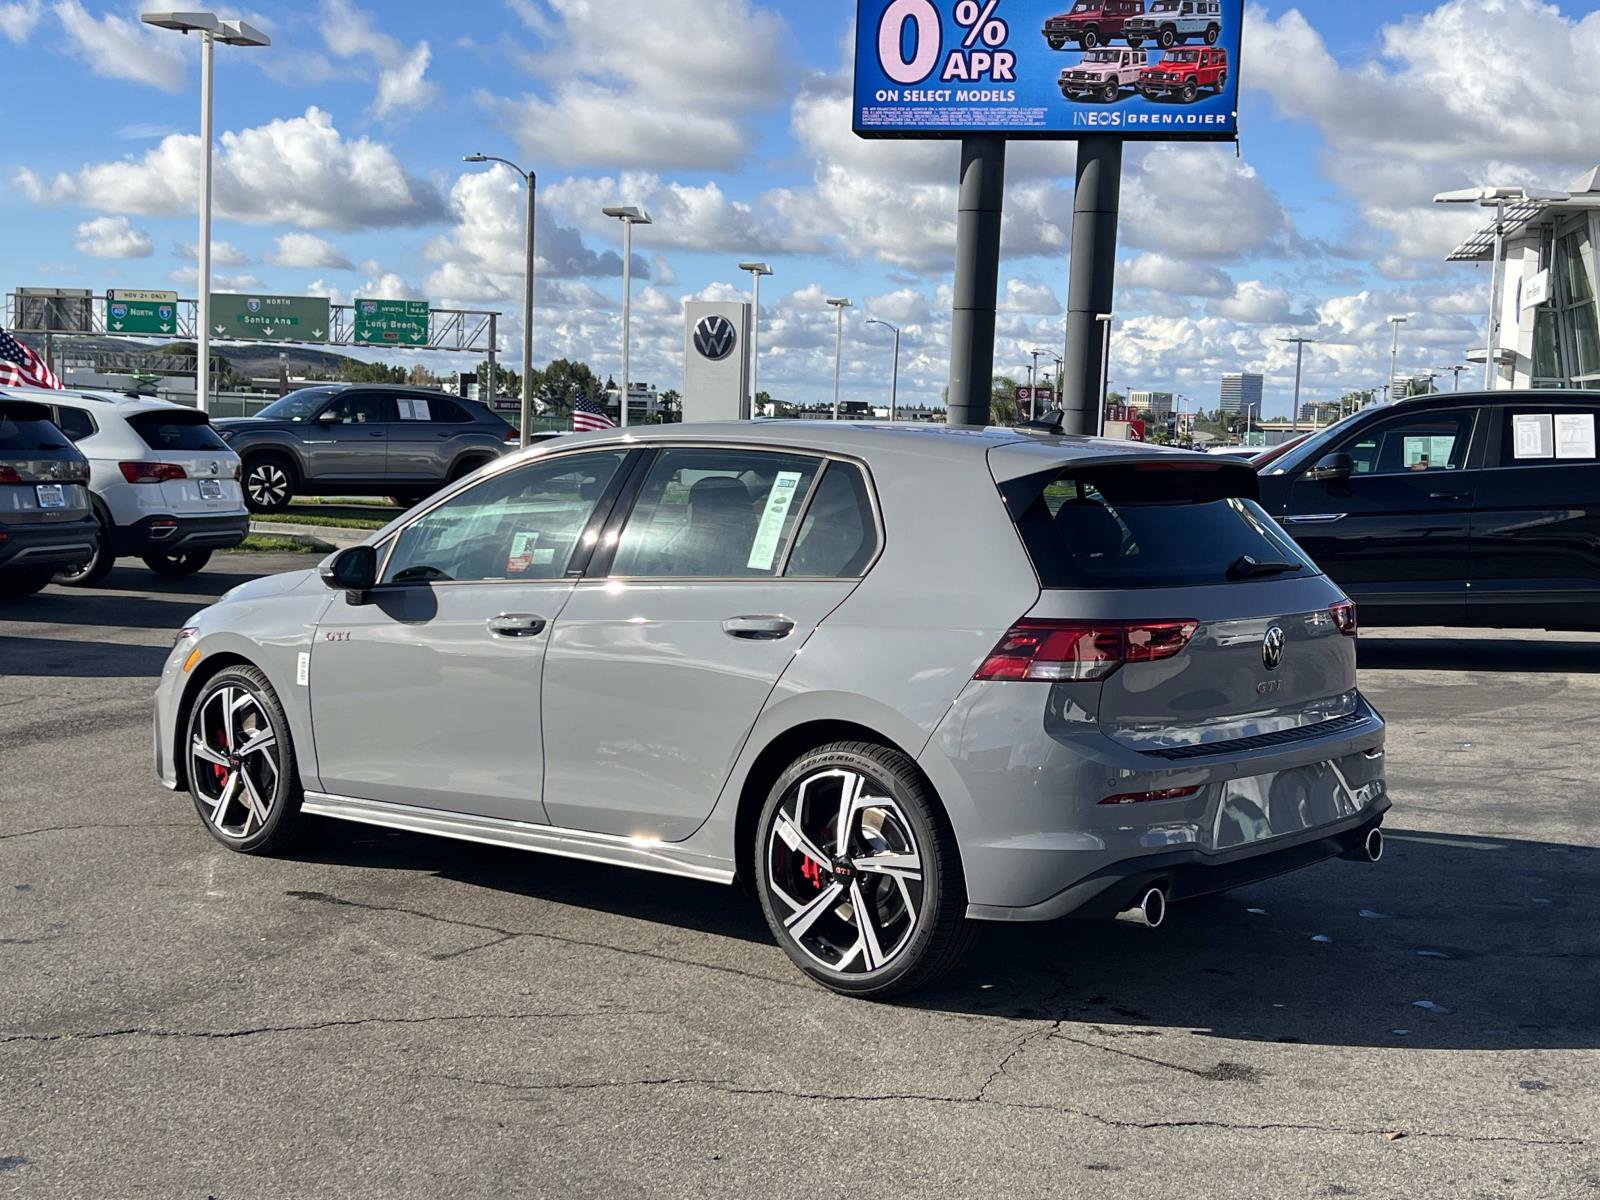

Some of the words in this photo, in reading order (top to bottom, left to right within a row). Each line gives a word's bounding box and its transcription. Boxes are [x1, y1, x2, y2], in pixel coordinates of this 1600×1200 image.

[942, 52, 1014, 80] APR
[875, 89, 899, 102] ON
[903, 89, 951, 102] SELECT
[956, 89, 1016, 102] MODELS
[1073, 111, 1121, 126] INEOS
[1127, 114, 1226, 124] GRENADIER
[244, 315, 270, 324] Santa
[274, 317, 291, 325] Ana
[365, 319, 387, 330] Long
[390, 320, 418, 330] Beach
[325, 631, 352, 642] GTI
[835, 866, 851, 876] GTI
